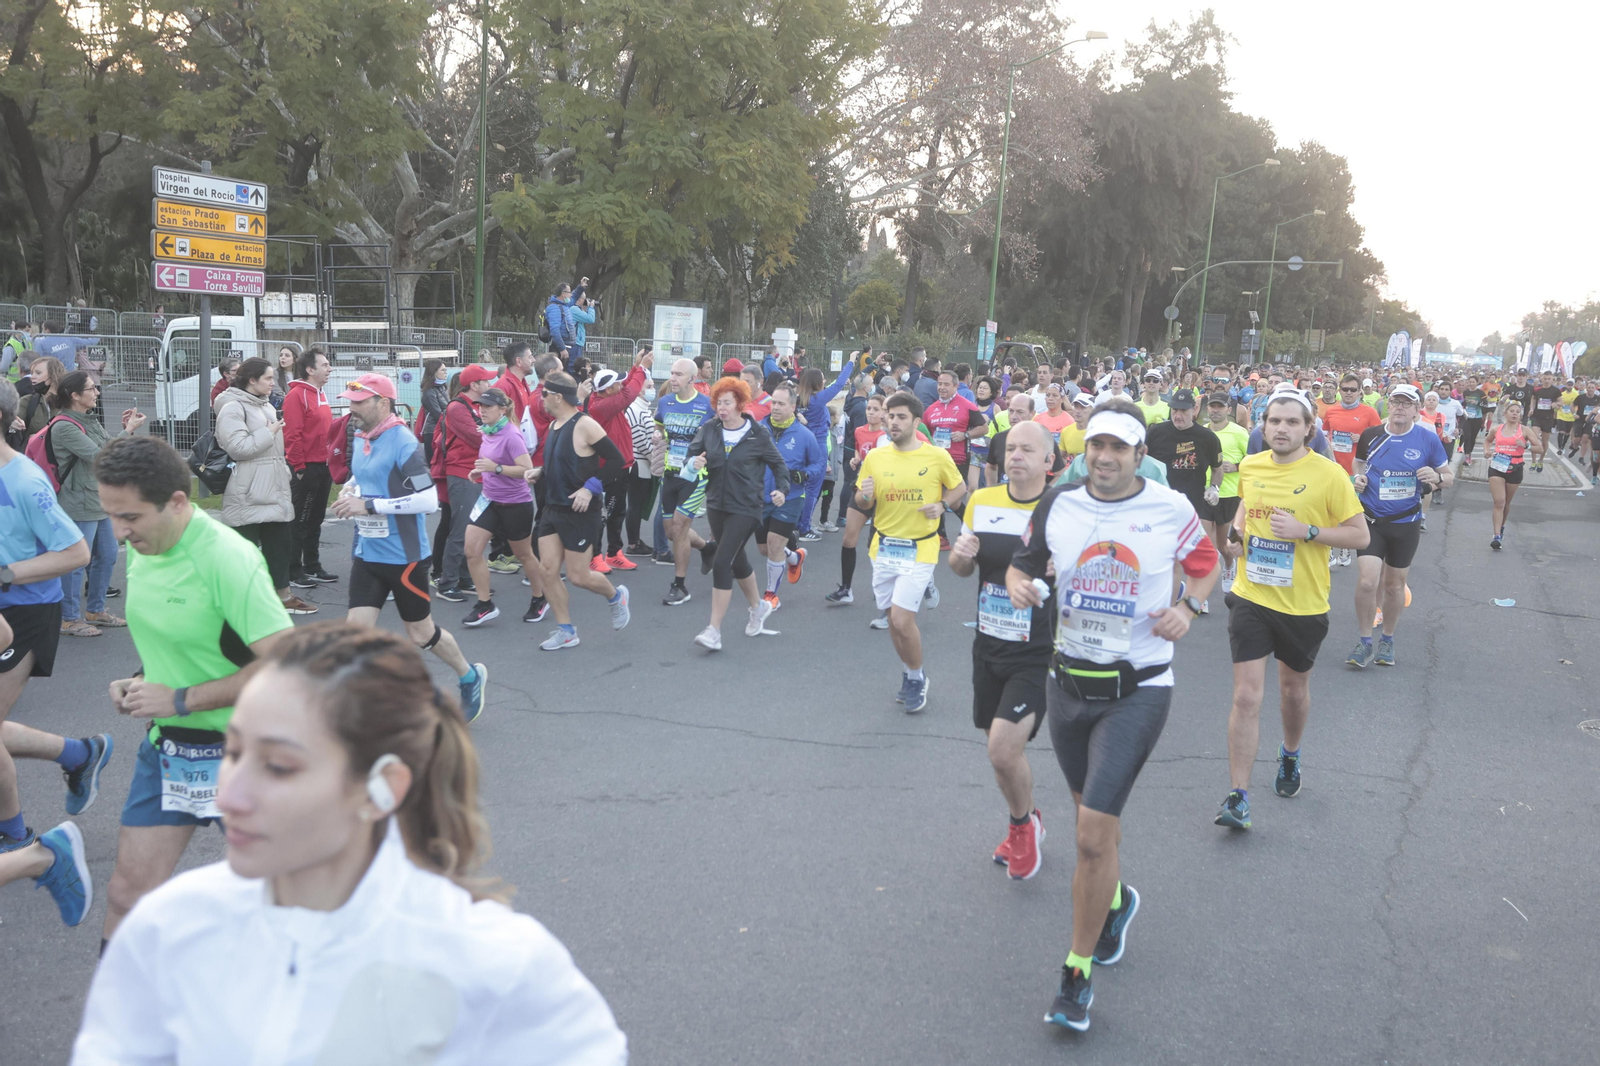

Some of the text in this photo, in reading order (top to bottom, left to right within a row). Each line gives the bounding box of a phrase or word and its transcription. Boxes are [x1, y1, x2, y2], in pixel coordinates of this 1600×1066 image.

[160, 172, 190, 183] hospital
[160, 181, 190, 195] Virgen
[193, 186, 208, 197] del
[160, 206, 219, 220] estación Prado
[160, 216, 226, 231] San Sebastián
[234, 244, 262, 253] estación
[191, 249, 262, 264] Plaza de Armas
[206, 270, 262, 283] Caixa Forum
[204, 280, 261, 294] Torre Sevilla
[1260, 540, 1288, 551] ZURICH
[1257, 555, 1277, 564] 10944
[1076, 557, 1140, 582] RECREATIVOS
[1072, 578, 1140, 595] QUIJOTE
[991, 604, 1013, 615] 11355
[1083, 599, 1126, 613] ZURICH
[981, 614, 998, 624] CARLOS
[1082, 620, 1106, 632] 9775
[1083, 636, 1102, 646] SAMI
[178, 746, 223, 758] ZURICH
[190, 789, 218, 799] ABEL
